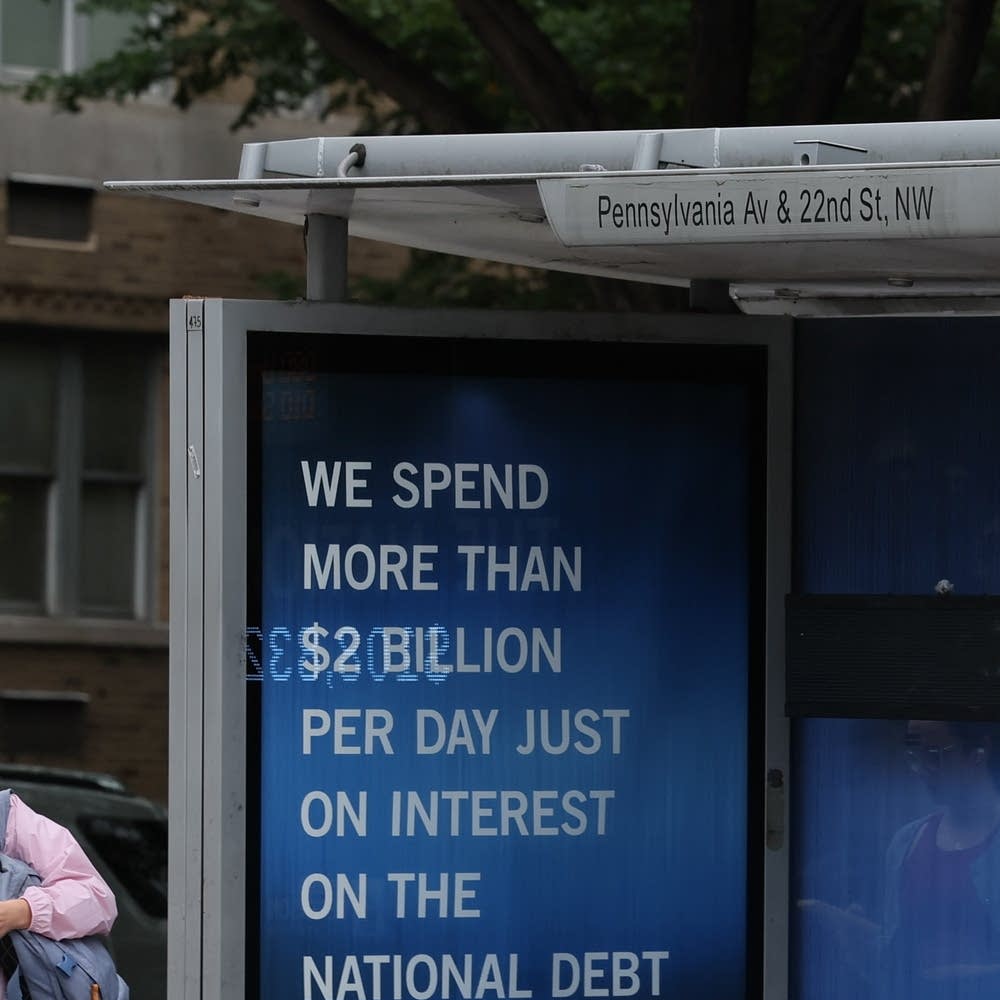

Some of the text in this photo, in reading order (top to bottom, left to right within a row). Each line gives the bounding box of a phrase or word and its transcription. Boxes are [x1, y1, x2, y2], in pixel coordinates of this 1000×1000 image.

[598, 185, 934, 236] Pennsylvania Av & 22nd St, NW
[301, 460, 549, 510] WE SPEND
[303, 543, 582, 592] MORE THAN
[301, 621, 562, 680] $2 BILLION
[302, 708, 631, 756] PER DAY JUST
[300, 789, 615, 838] ON INTEREST
[300, 872, 481, 920] ON THE
[551, 950, 669, 998] DEBT
